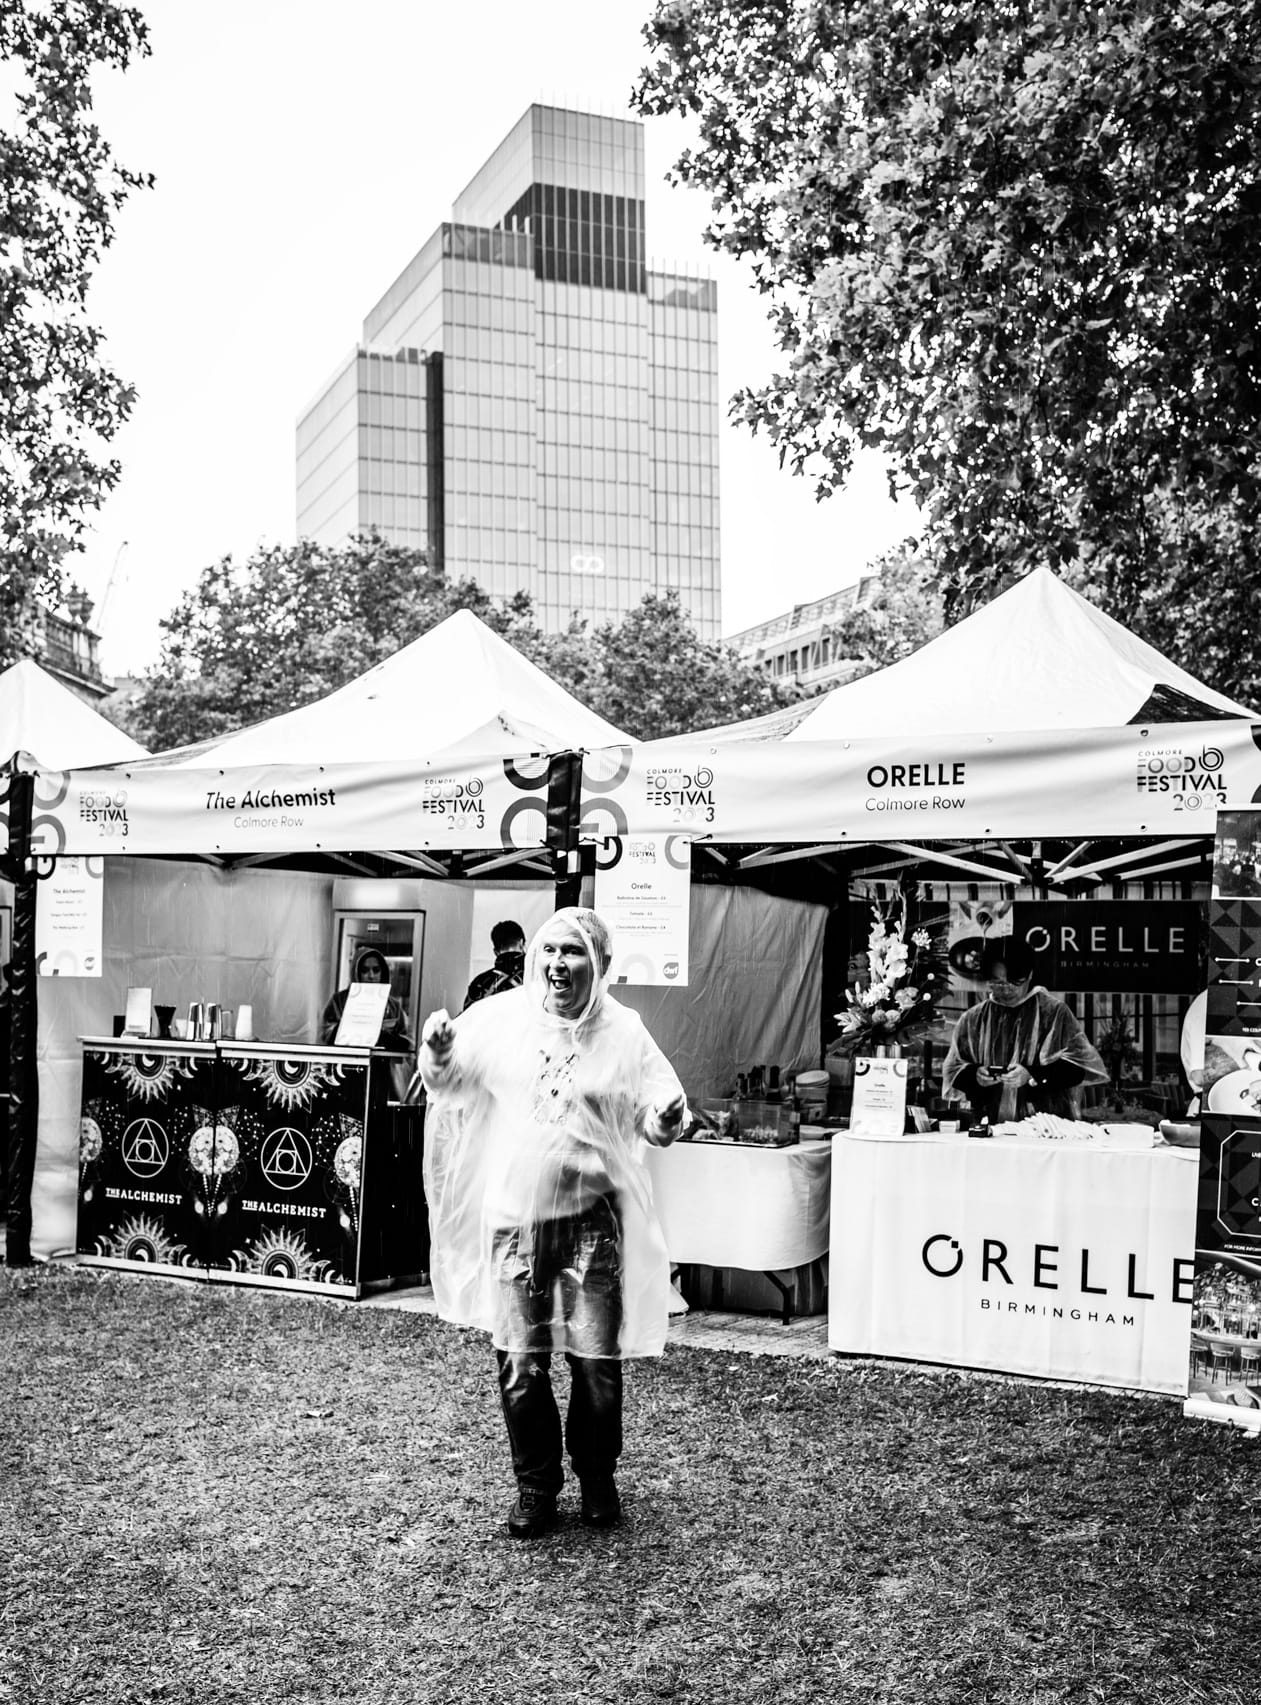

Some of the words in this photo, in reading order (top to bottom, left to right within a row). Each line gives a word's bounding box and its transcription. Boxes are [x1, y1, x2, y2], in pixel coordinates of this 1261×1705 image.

[1137, 756, 1196, 774] FOOD
[867, 763, 965, 788] ORELLE
[1137, 774, 1227, 792] FESTIVAL
[206, 791, 236, 809] The
[241, 787, 336, 809] Alchemist
[422, 799, 486, 814] FESTIVAL
[646, 790, 716, 806] FESTIVAL
[865, 797, 928, 811] Colmore
[932, 796, 966, 809] Row
[79, 809, 129, 822] FESTIVAL
[233, 816, 279, 829] Colmore
[281, 815, 305, 826] Row
[631, 882, 652, 890] Orelle
[1025, 926, 1185, 953] ORELLE
[105, 1187, 120, 1198] THE
[120, 1189, 183, 1205] ALCHEMIST
[242, 1200, 257, 1211] THE
[258, 1201, 327, 1218] ALCHEMIST
[922, 1234, 1196, 1304] ORELLE
[980, 1298, 1135, 1326] BIRMINGHAM
